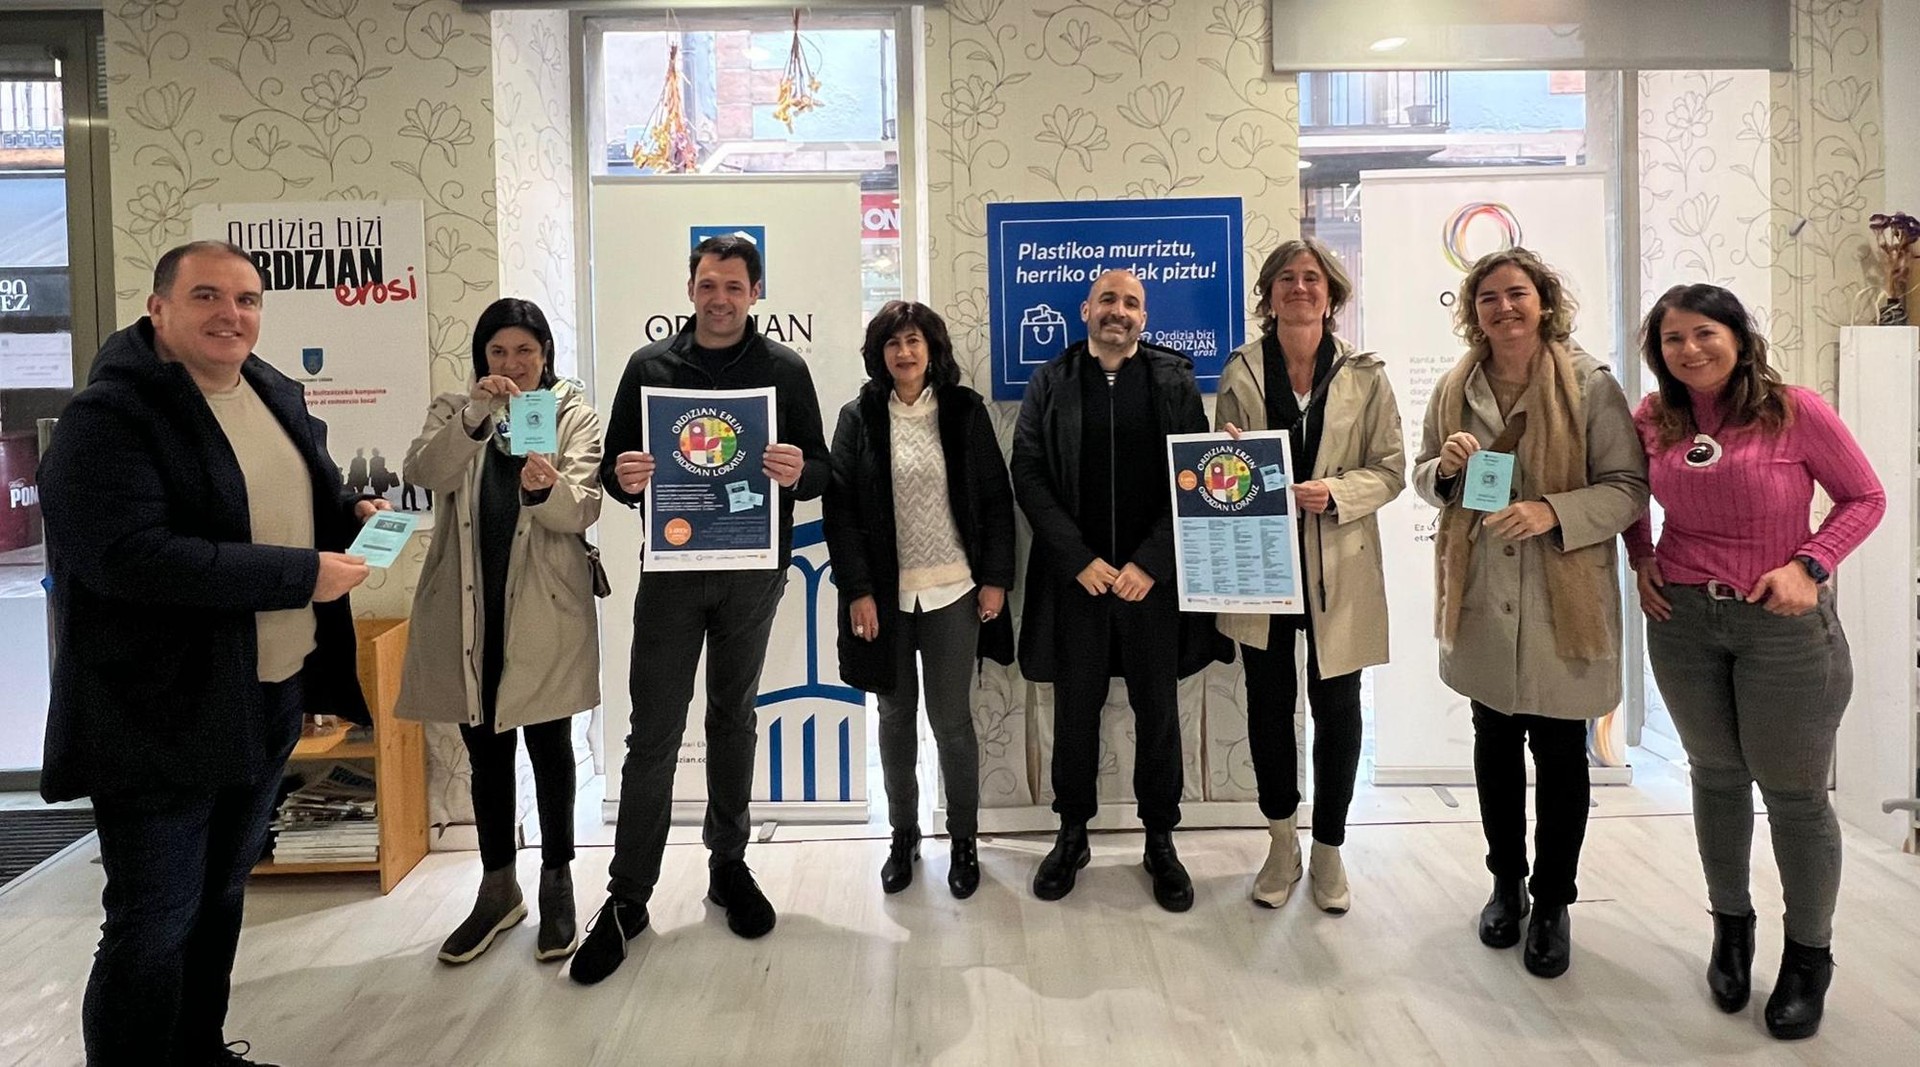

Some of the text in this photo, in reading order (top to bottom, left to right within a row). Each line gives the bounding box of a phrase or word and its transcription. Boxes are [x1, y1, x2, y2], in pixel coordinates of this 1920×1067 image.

[337, 216, 382, 248] bizi
[1018, 239, 1196, 260] Plastikoa murriztu,
[251, 248, 383, 290] RDIZIAN
[1016, 265, 1085, 283] herriko
[1162, 261, 1217, 283] piztu!
[335, 266, 417, 306] erosi
[1155, 329, 1215, 340] Ordizia bizi
[1193, 347, 1217, 357] erosi
[672, 407, 745, 434] ORDIZIAN EREIN
[672, 449, 747, 477] ORDIZIAN LORATUZ
[1197, 445, 1257, 471] ORDIZIAN EREIN
[1198, 484, 1260, 511] ORDIZIAN LORATUZ
